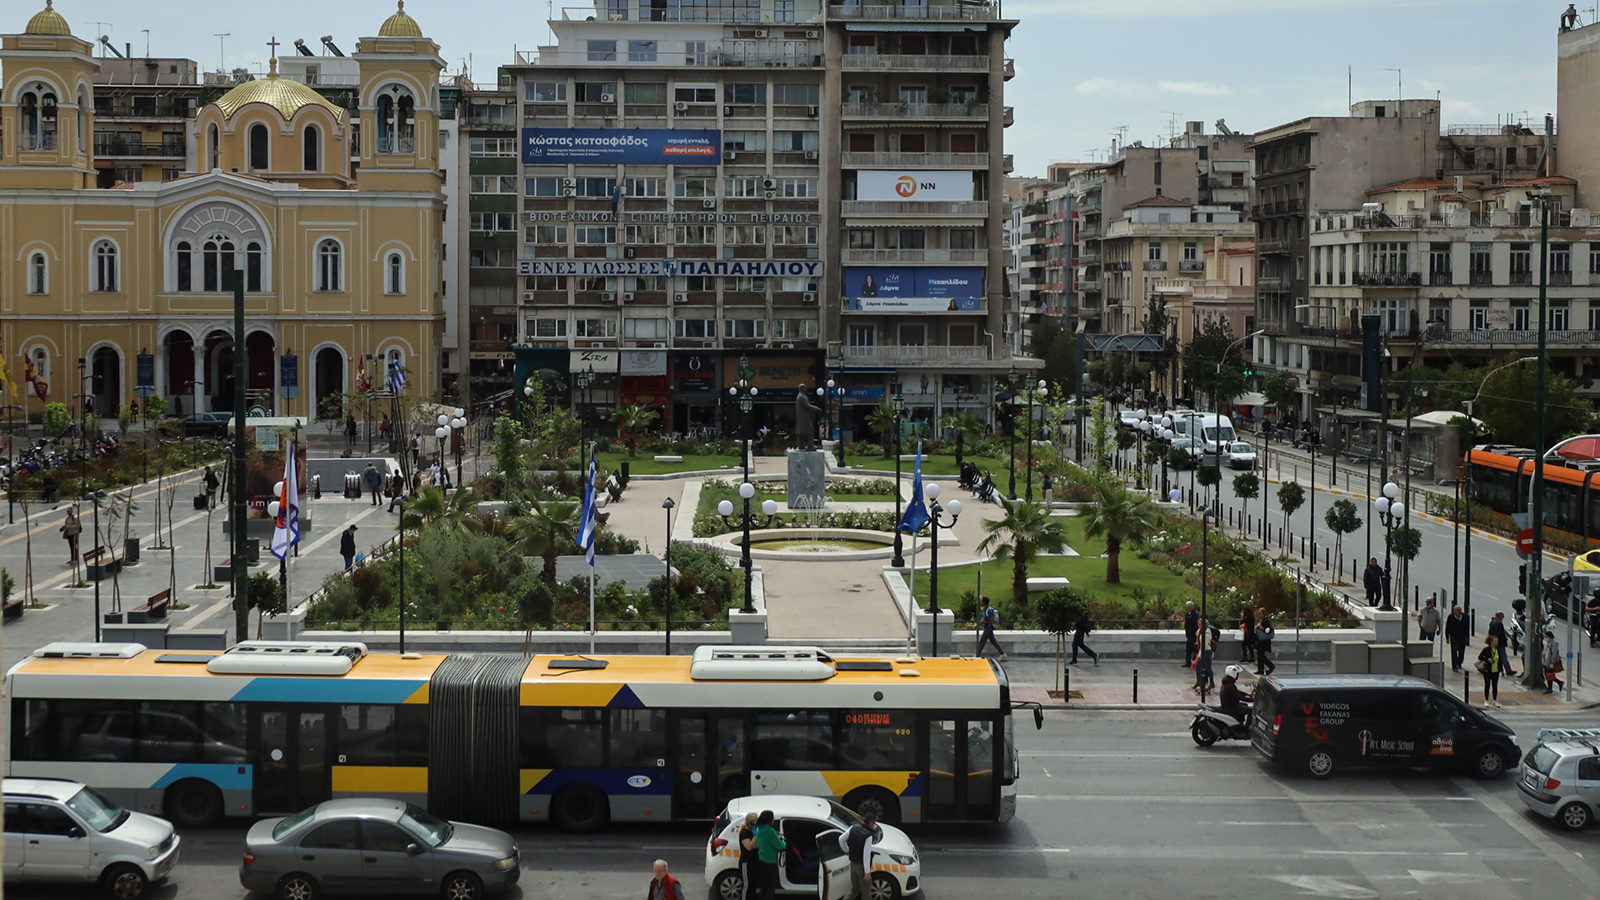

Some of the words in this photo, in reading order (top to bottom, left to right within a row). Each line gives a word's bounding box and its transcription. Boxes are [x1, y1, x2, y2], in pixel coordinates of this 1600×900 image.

[529, 135, 573, 147] κώστας
[575, 135, 648, 147] κατσαφάδος
[920, 182, 936, 190] NN
[529, 212, 617, 221] ΒΙΟΤΕΧΝΙΚΟΝ
[631, 213, 737, 222] ΕΠΙΜΕΛΗΤΗΡΙΟΝ
[750, 213, 811, 223] ΠΕΙΡΑΙΩΣ
[520, 262, 577, 274] ΞΕΝΕΣ
[583, 262, 660, 274] ΓΛΩΣΣΕΣ
[680, 262, 819, 275] ΠΑΠΑΗΛΙΟΥ
[845, 714, 864, 724] 040
[1397, 740, 1415, 750] School
